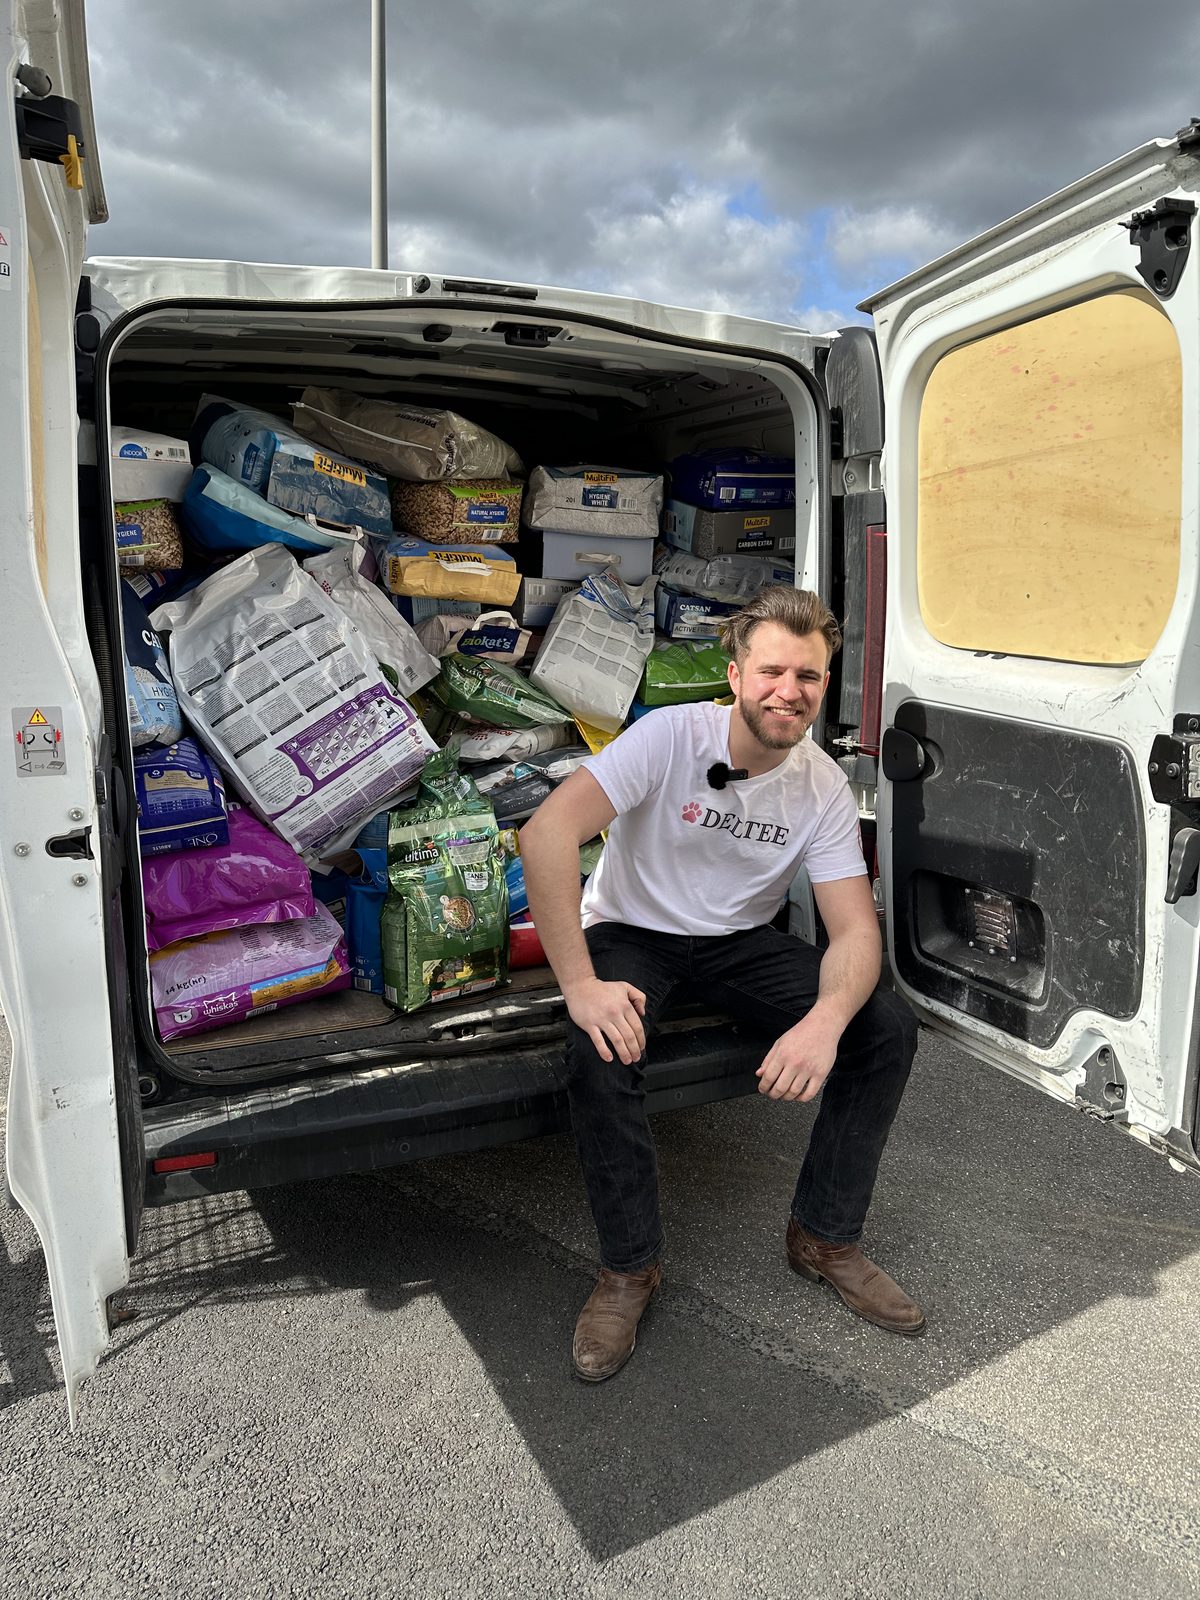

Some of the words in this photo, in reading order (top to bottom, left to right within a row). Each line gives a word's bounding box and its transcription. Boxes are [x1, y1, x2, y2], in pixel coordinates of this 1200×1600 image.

[123, 448, 143, 456] INDOOR
[317, 455, 364, 483] MultiFit
[586, 474, 615, 482] MultiFit
[745, 518, 769, 527] MultiFit
[116, 529, 138, 538] YGIENE
[433, 552, 482, 564] MultiFit
[679, 604, 712, 613] CATSAN
[674, 625, 697, 633] ACTIVE
[700, 808, 789, 845] DELTEE
[187, 833, 217, 846] ONE
[404, 848, 439, 863] ultima
[203, 999, 239, 1016] whiskas
